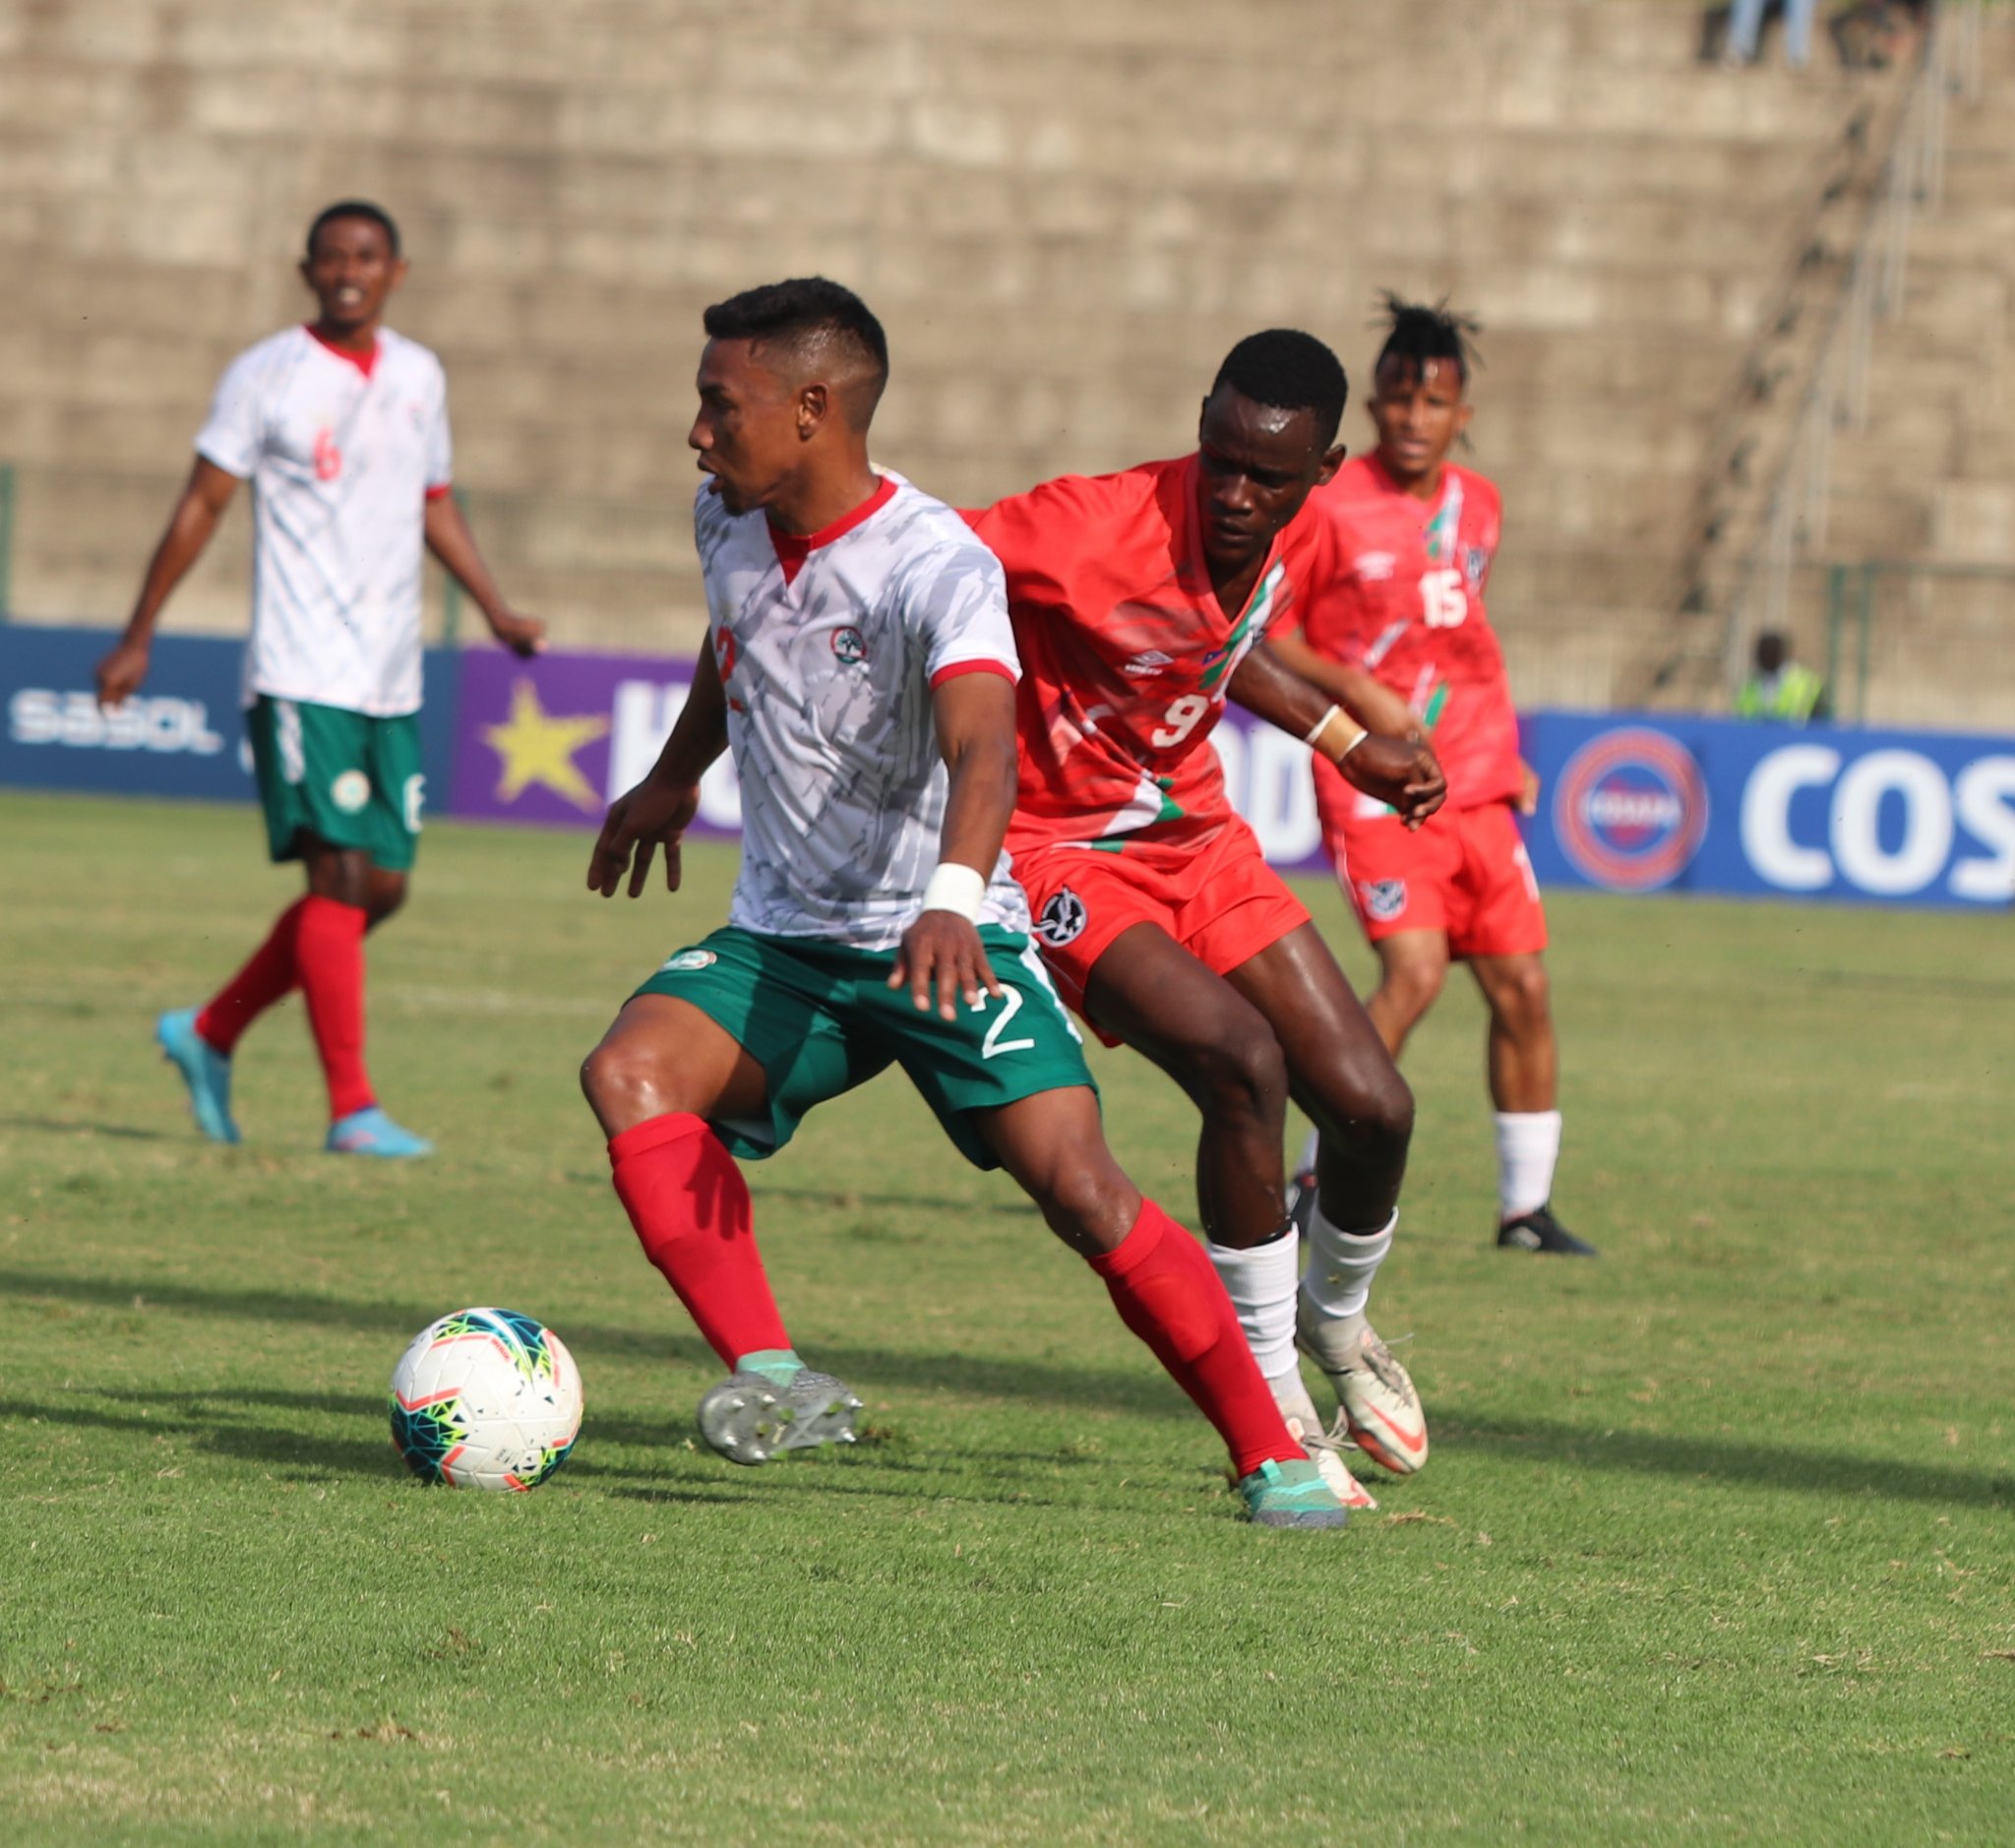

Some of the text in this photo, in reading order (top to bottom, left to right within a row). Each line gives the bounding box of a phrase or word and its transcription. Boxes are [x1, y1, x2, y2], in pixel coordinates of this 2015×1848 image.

[314, 426, 341, 482] 6
[1418, 568, 1468, 628] 15
[1150, 693, 1210, 749] 9
[970, 982, 1035, 1060] 2
